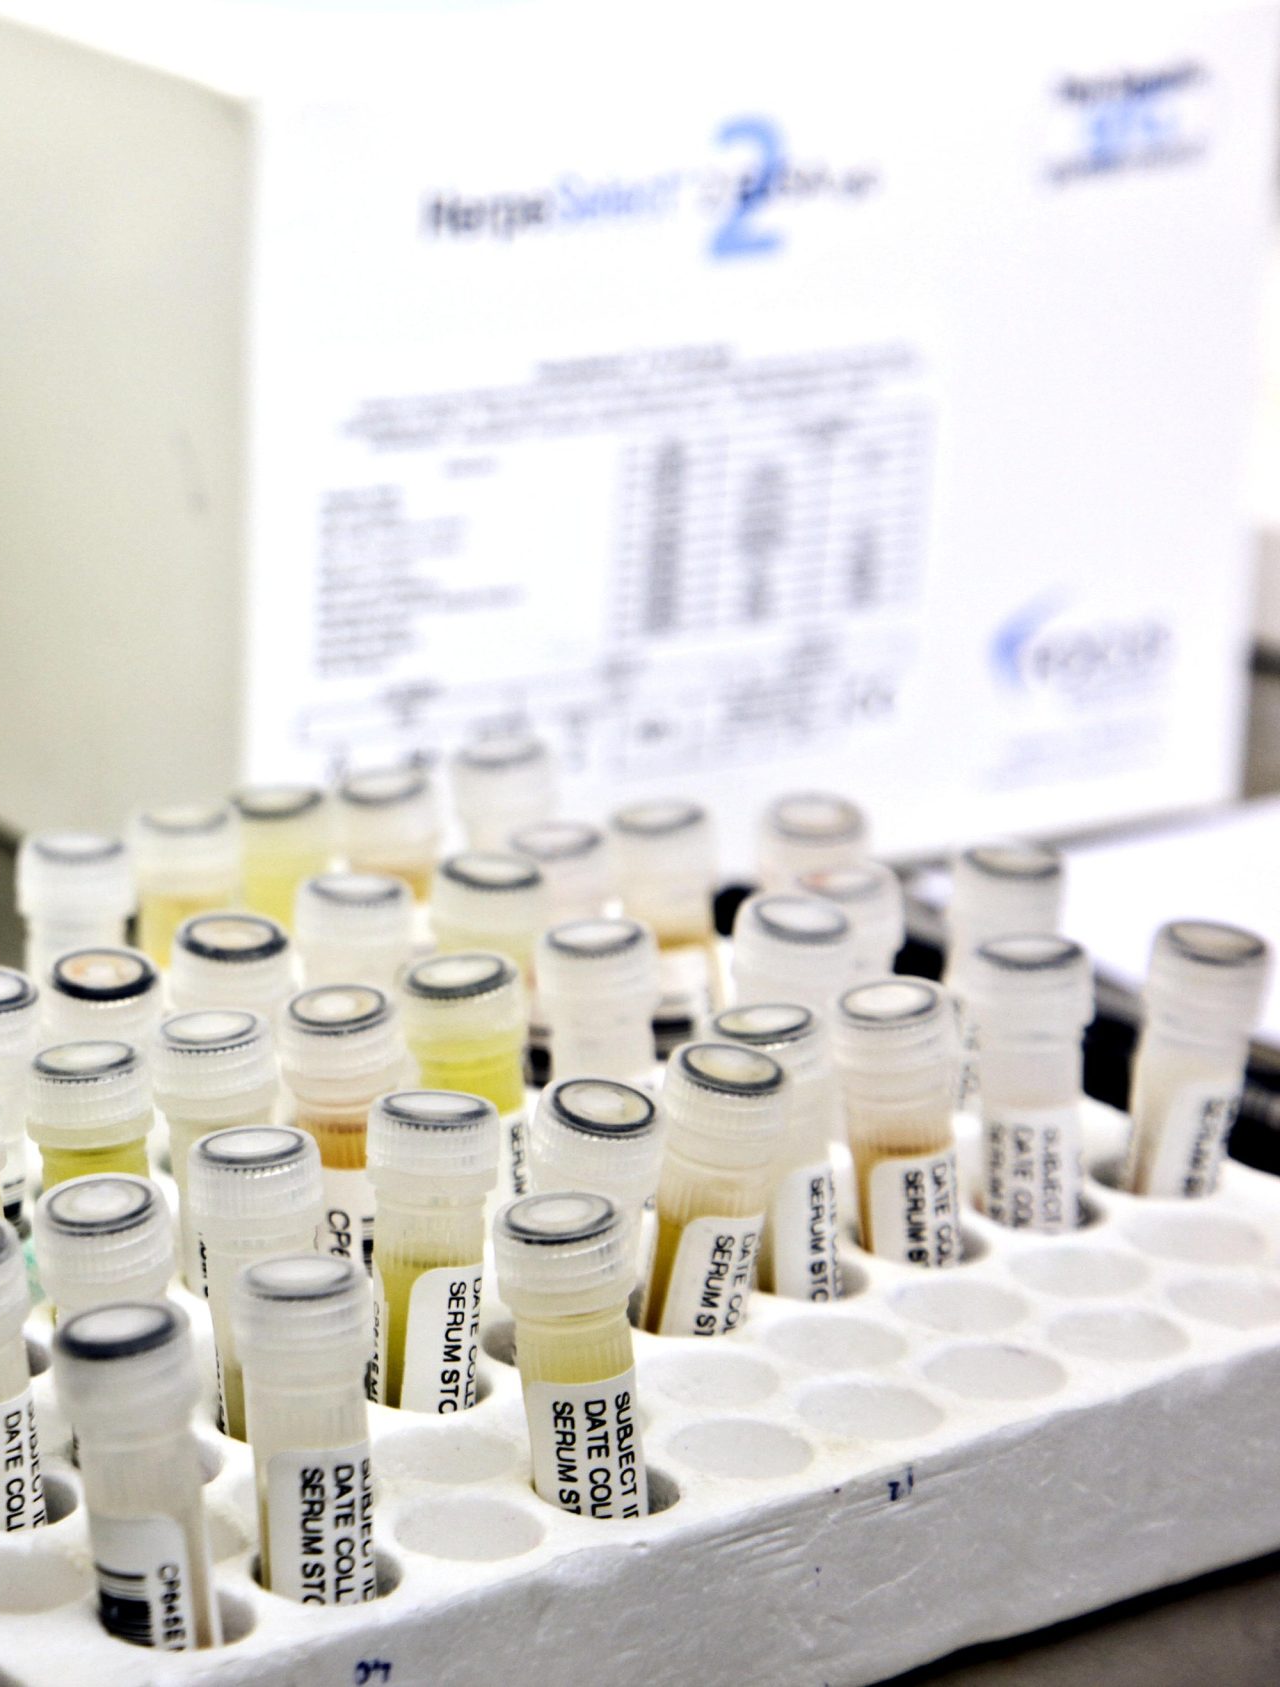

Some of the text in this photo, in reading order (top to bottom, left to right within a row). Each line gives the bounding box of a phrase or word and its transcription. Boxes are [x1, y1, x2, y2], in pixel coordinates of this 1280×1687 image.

[701, 1235, 735, 1308] SERUM
[442, 1281, 467, 1363] SERUM
[5, 1410, 24, 1472] DATE
[552, 1401, 578, 1483] SERUM
[584, 1399, 610, 1459] DATE
[615, 1391, 638, 1496] SUBJECT
[301, 1467, 326, 1555] SERUM
[334, 1464, 355, 1529] DATE
